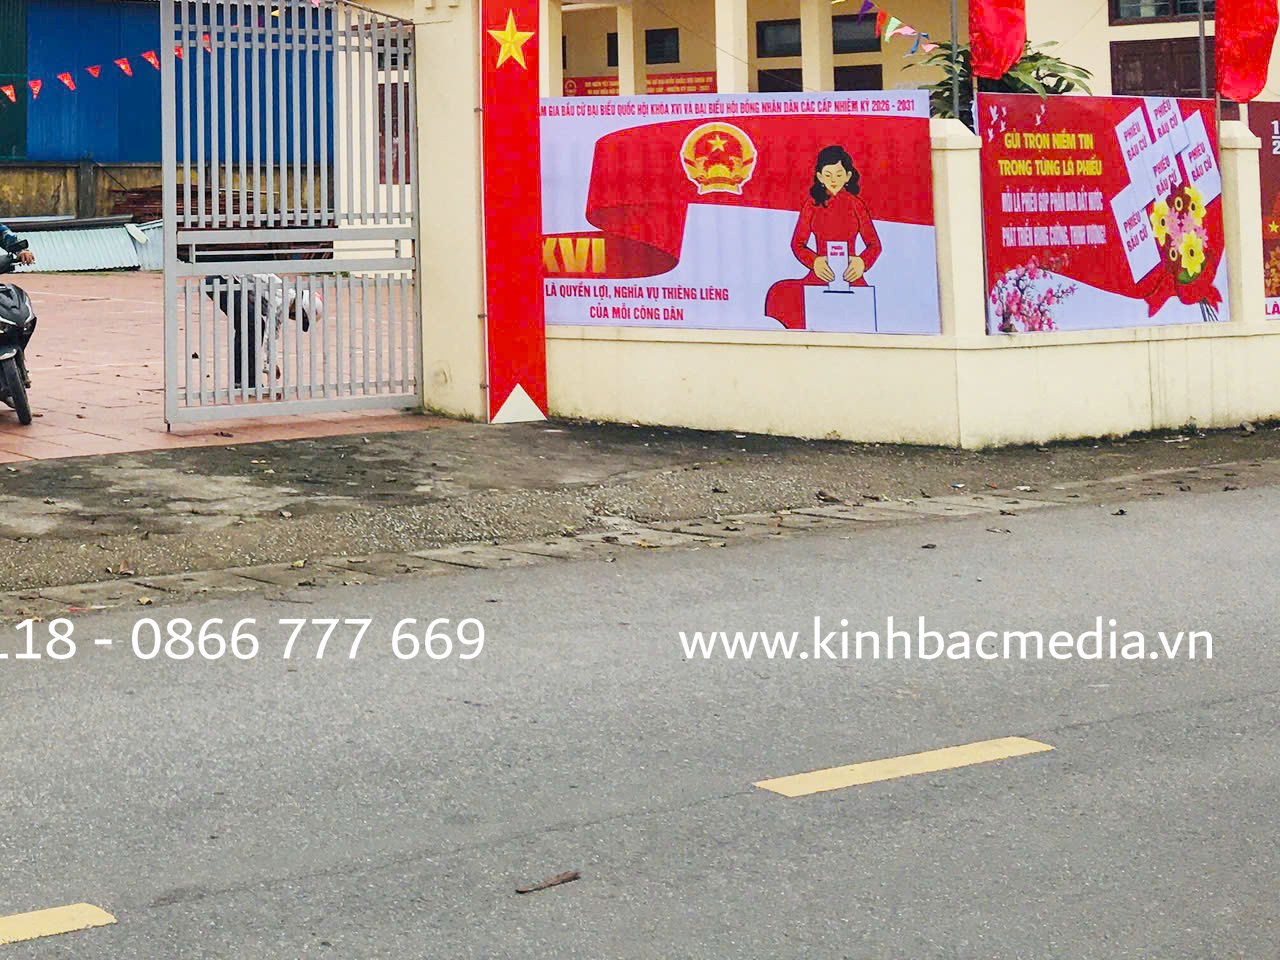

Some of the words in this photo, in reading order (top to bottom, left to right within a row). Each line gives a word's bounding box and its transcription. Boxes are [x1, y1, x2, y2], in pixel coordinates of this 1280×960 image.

[545, 284, 557, 297] LÀ
[560, 281, 590, 297] QUYỀN
[593, 284, 611, 300] LỢI,
[614, 284, 644, 299] NGHĨA
[647, 287, 659, 302] VỤ
[662, 285, 697, 300] THIÊNG
[700, 286, 729, 301] LIÊNG
[590, 302, 609, 319] CỦA
[634, 305, 660, 320] CÔNG
[663, 306, 684, 320] DÂN
